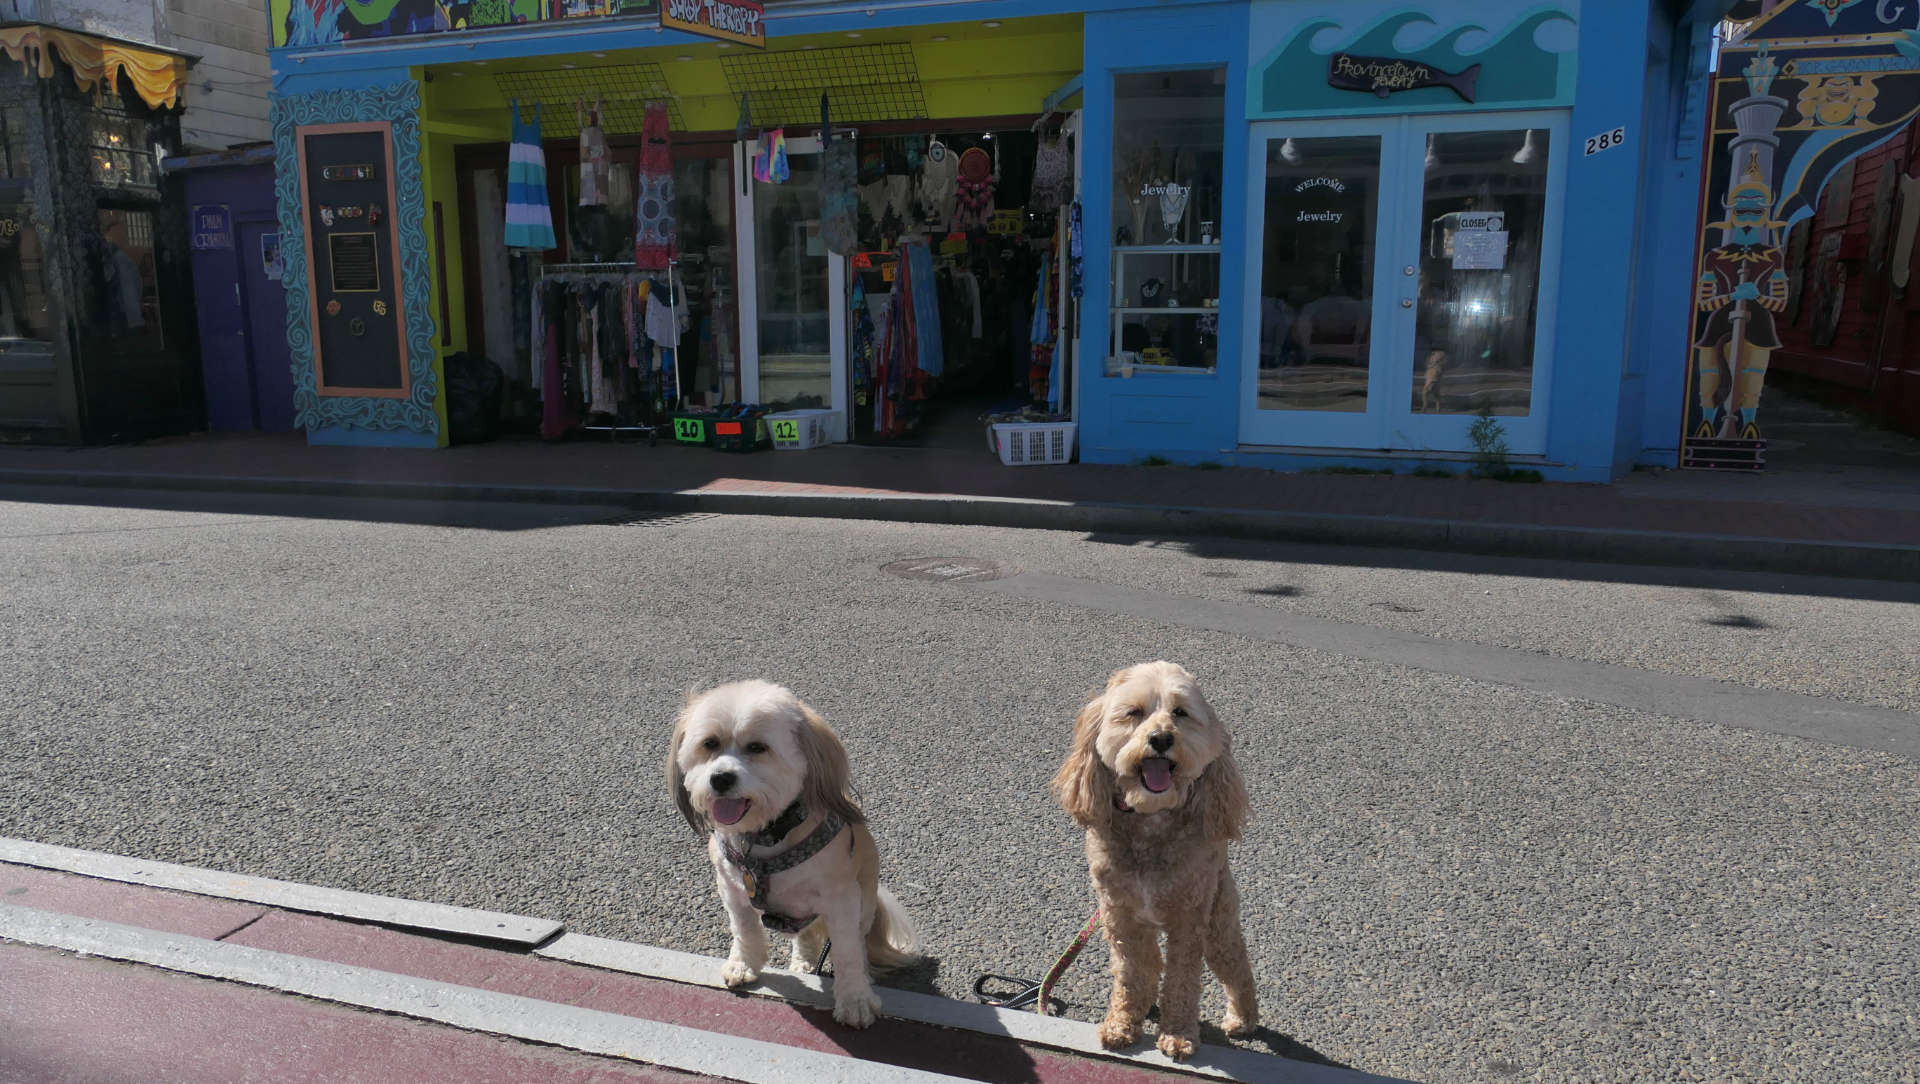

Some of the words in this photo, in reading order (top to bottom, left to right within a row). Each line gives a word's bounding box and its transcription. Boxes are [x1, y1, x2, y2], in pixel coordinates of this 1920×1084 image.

[704, 0, 759, 36] THERAPY
[1586, 128, 1624, 155] 286
[1140, 183, 1192, 198] Jewelry
[1295, 176, 1345, 193] WELCOME
[1296, 210, 1343, 223] Jewelry
[1460, 218, 1487, 228] CLOSED
